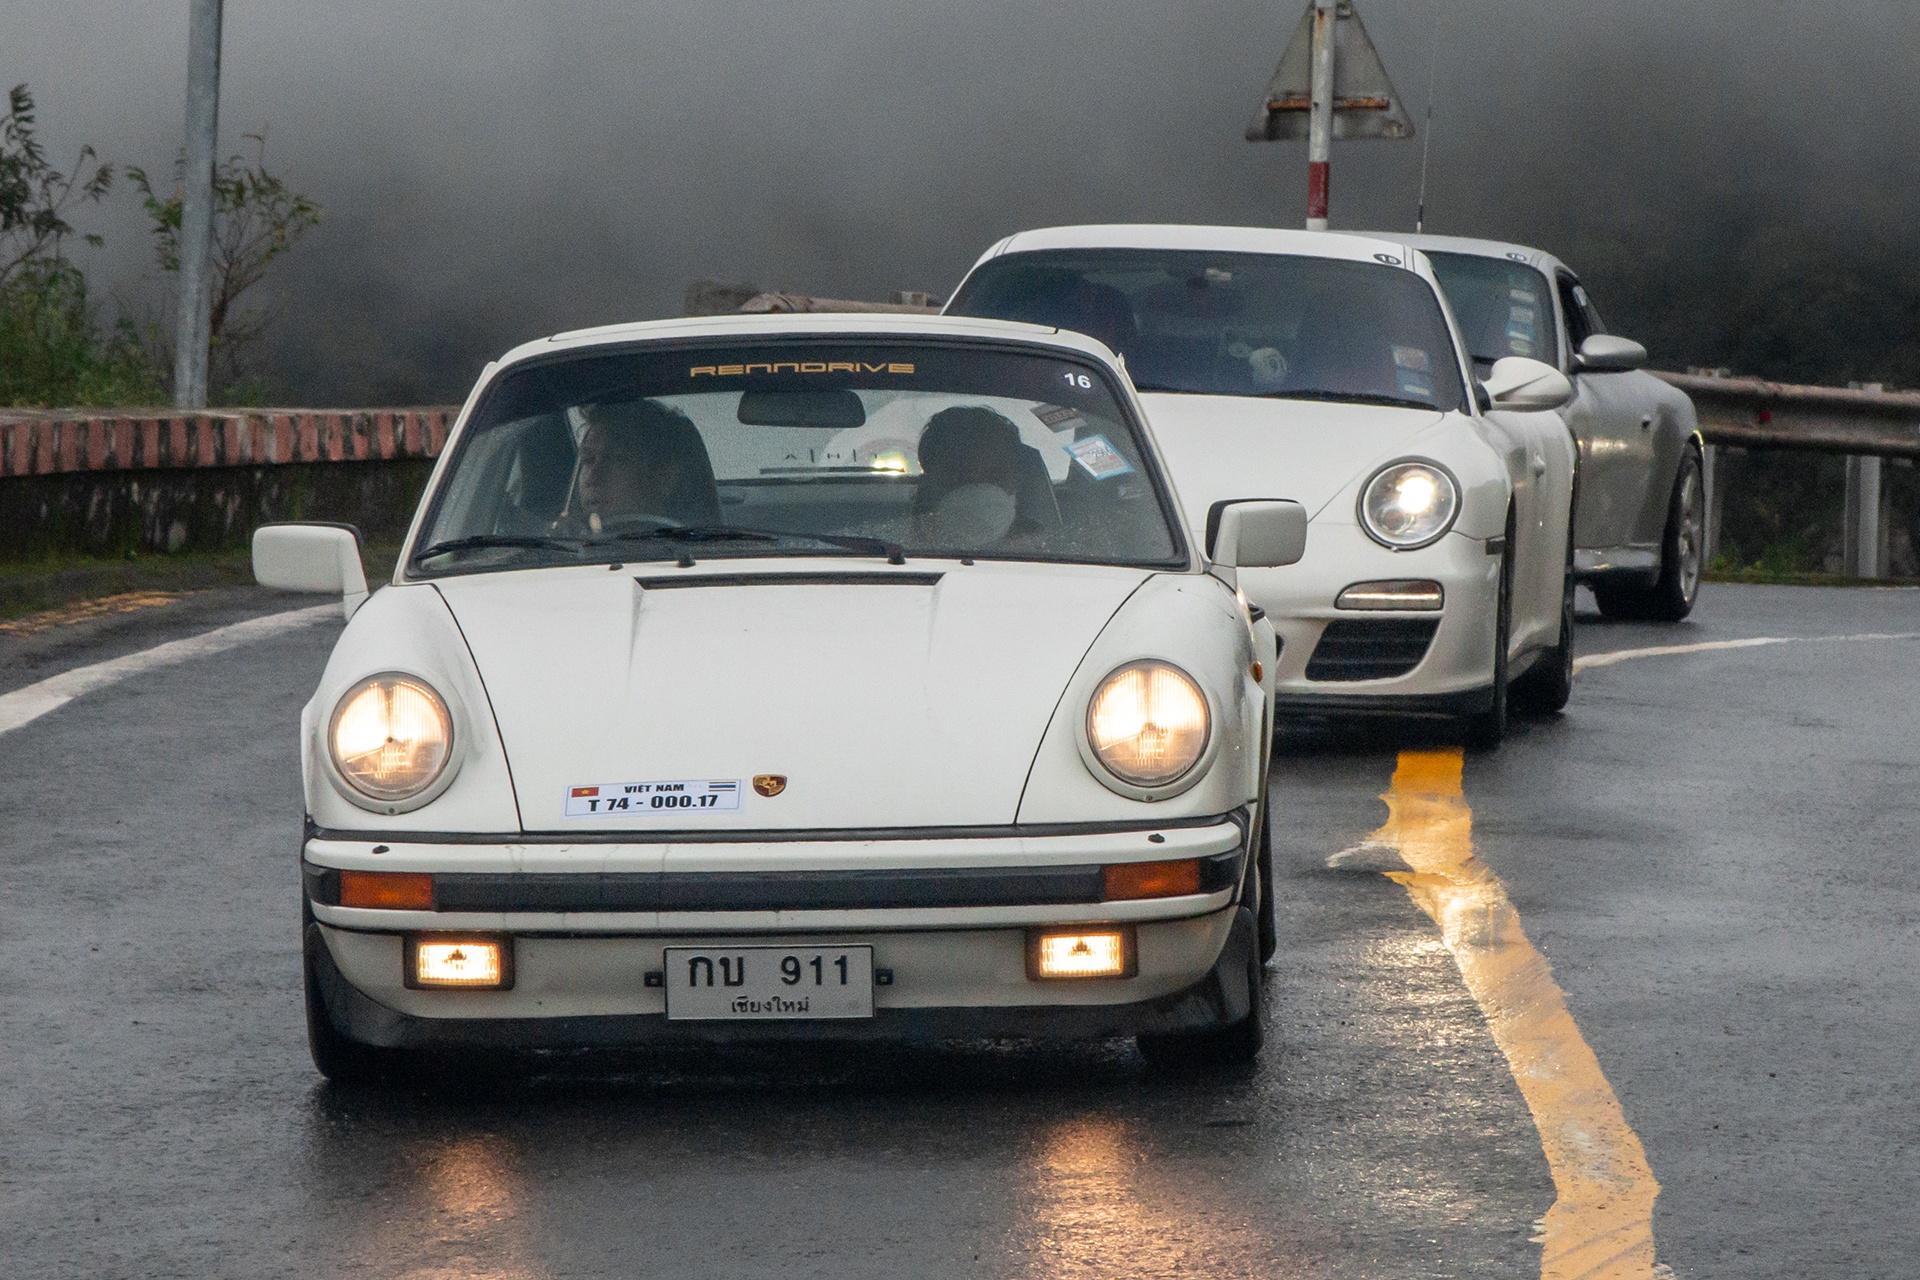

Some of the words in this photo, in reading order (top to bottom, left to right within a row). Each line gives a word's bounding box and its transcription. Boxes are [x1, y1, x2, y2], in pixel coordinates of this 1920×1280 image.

[690, 362, 915, 377] RENNDRIVE
[1064, 373, 1092, 389] 16
[656, 784, 684, 792] NAM
[588, 799, 600, 811] T
[606, 798, 629, 810] 74
[651, 795, 718, 808] 000.17
[781, 955, 847, 985] 911
[732, 996, 809, 1013] เชียงใหม่
